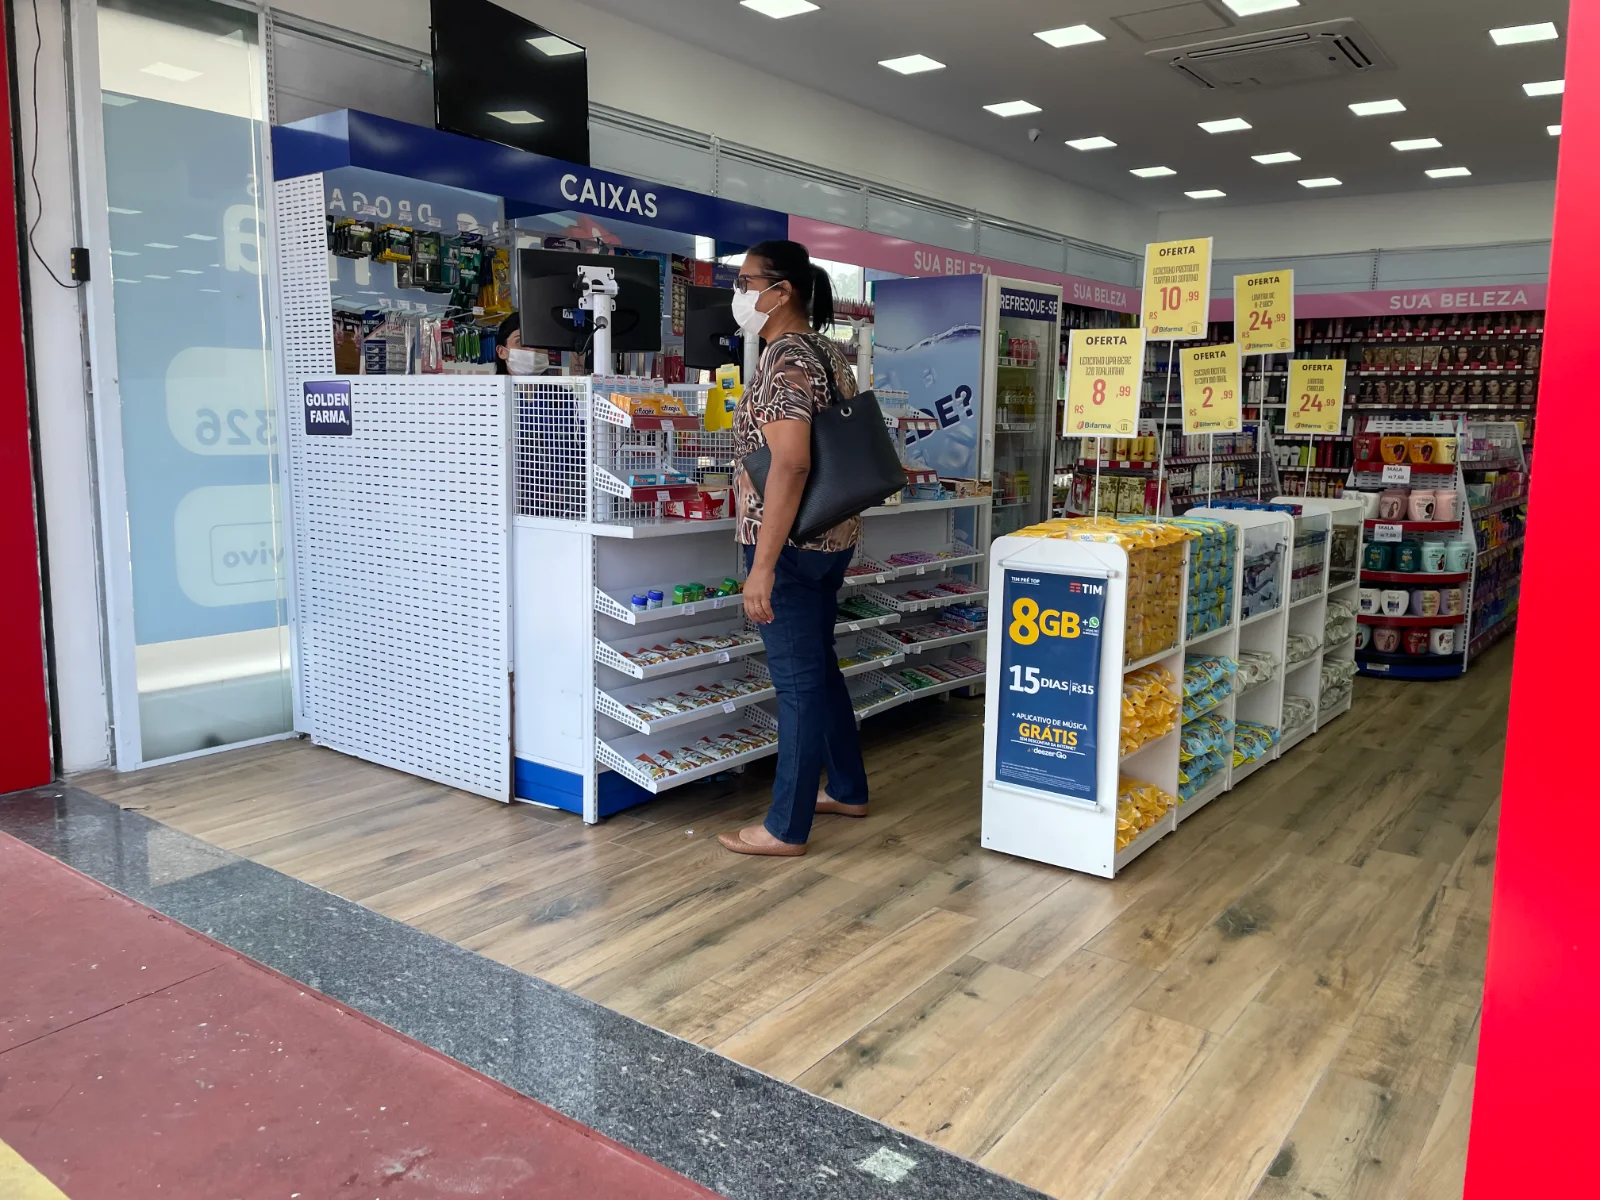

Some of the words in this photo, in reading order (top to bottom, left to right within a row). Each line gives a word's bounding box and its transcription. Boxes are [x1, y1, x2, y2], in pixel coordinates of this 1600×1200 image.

[560, 173, 658, 218] CAIXAS
[1159, 246, 1195, 257] OFERTA
[914, 250, 941, 273] SUA
[1247, 276, 1280, 286] OFERTA
[1000, 294, 1057, 315] REFRESQUE-SE
[1073, 283, 1092, 301] SUA
[1094, 288, 1127, 307] BELEZA
[1160, 286, 1182, 311] 10
[1389, 294, 1433, 310] SUA
[1440, 290, 1528, 308] BELEZA
[1149, 311, 1158, 320] R$
[1249, 310, 1273, 331] 24
[1086, 336, 1127, 345] OFERTA
[1193, 351, 1226, 360] OFERTA
[306, 393, 349, 407] GOLDEN
[1092, 378, 1106, 405] 8
[1202, 386, 1213, 408] 2
[1074, 404, 1084, 414] R$
[1189, 408, 1197, 416] R$
[1300, 393, 1323, 412] 24
[310, 410, 346, 423] FARMA
[1084, 421, 1111, 429] Bifarma
[1082, 584, 1102, 595] TIM
[1009, 597, 1080, 645] 8GB
[1009, 665, 1040, 694] 15
[1040, 678, 1069, 691] DIAS
[1016, 712, 1052, 725] APLICATIVO
[1062, 720, 1087, 731] MÚSICA
[1019, 722, 1078, 746] GRÁTIS
[1028, 738, 1050, 746] DESCONTAR
